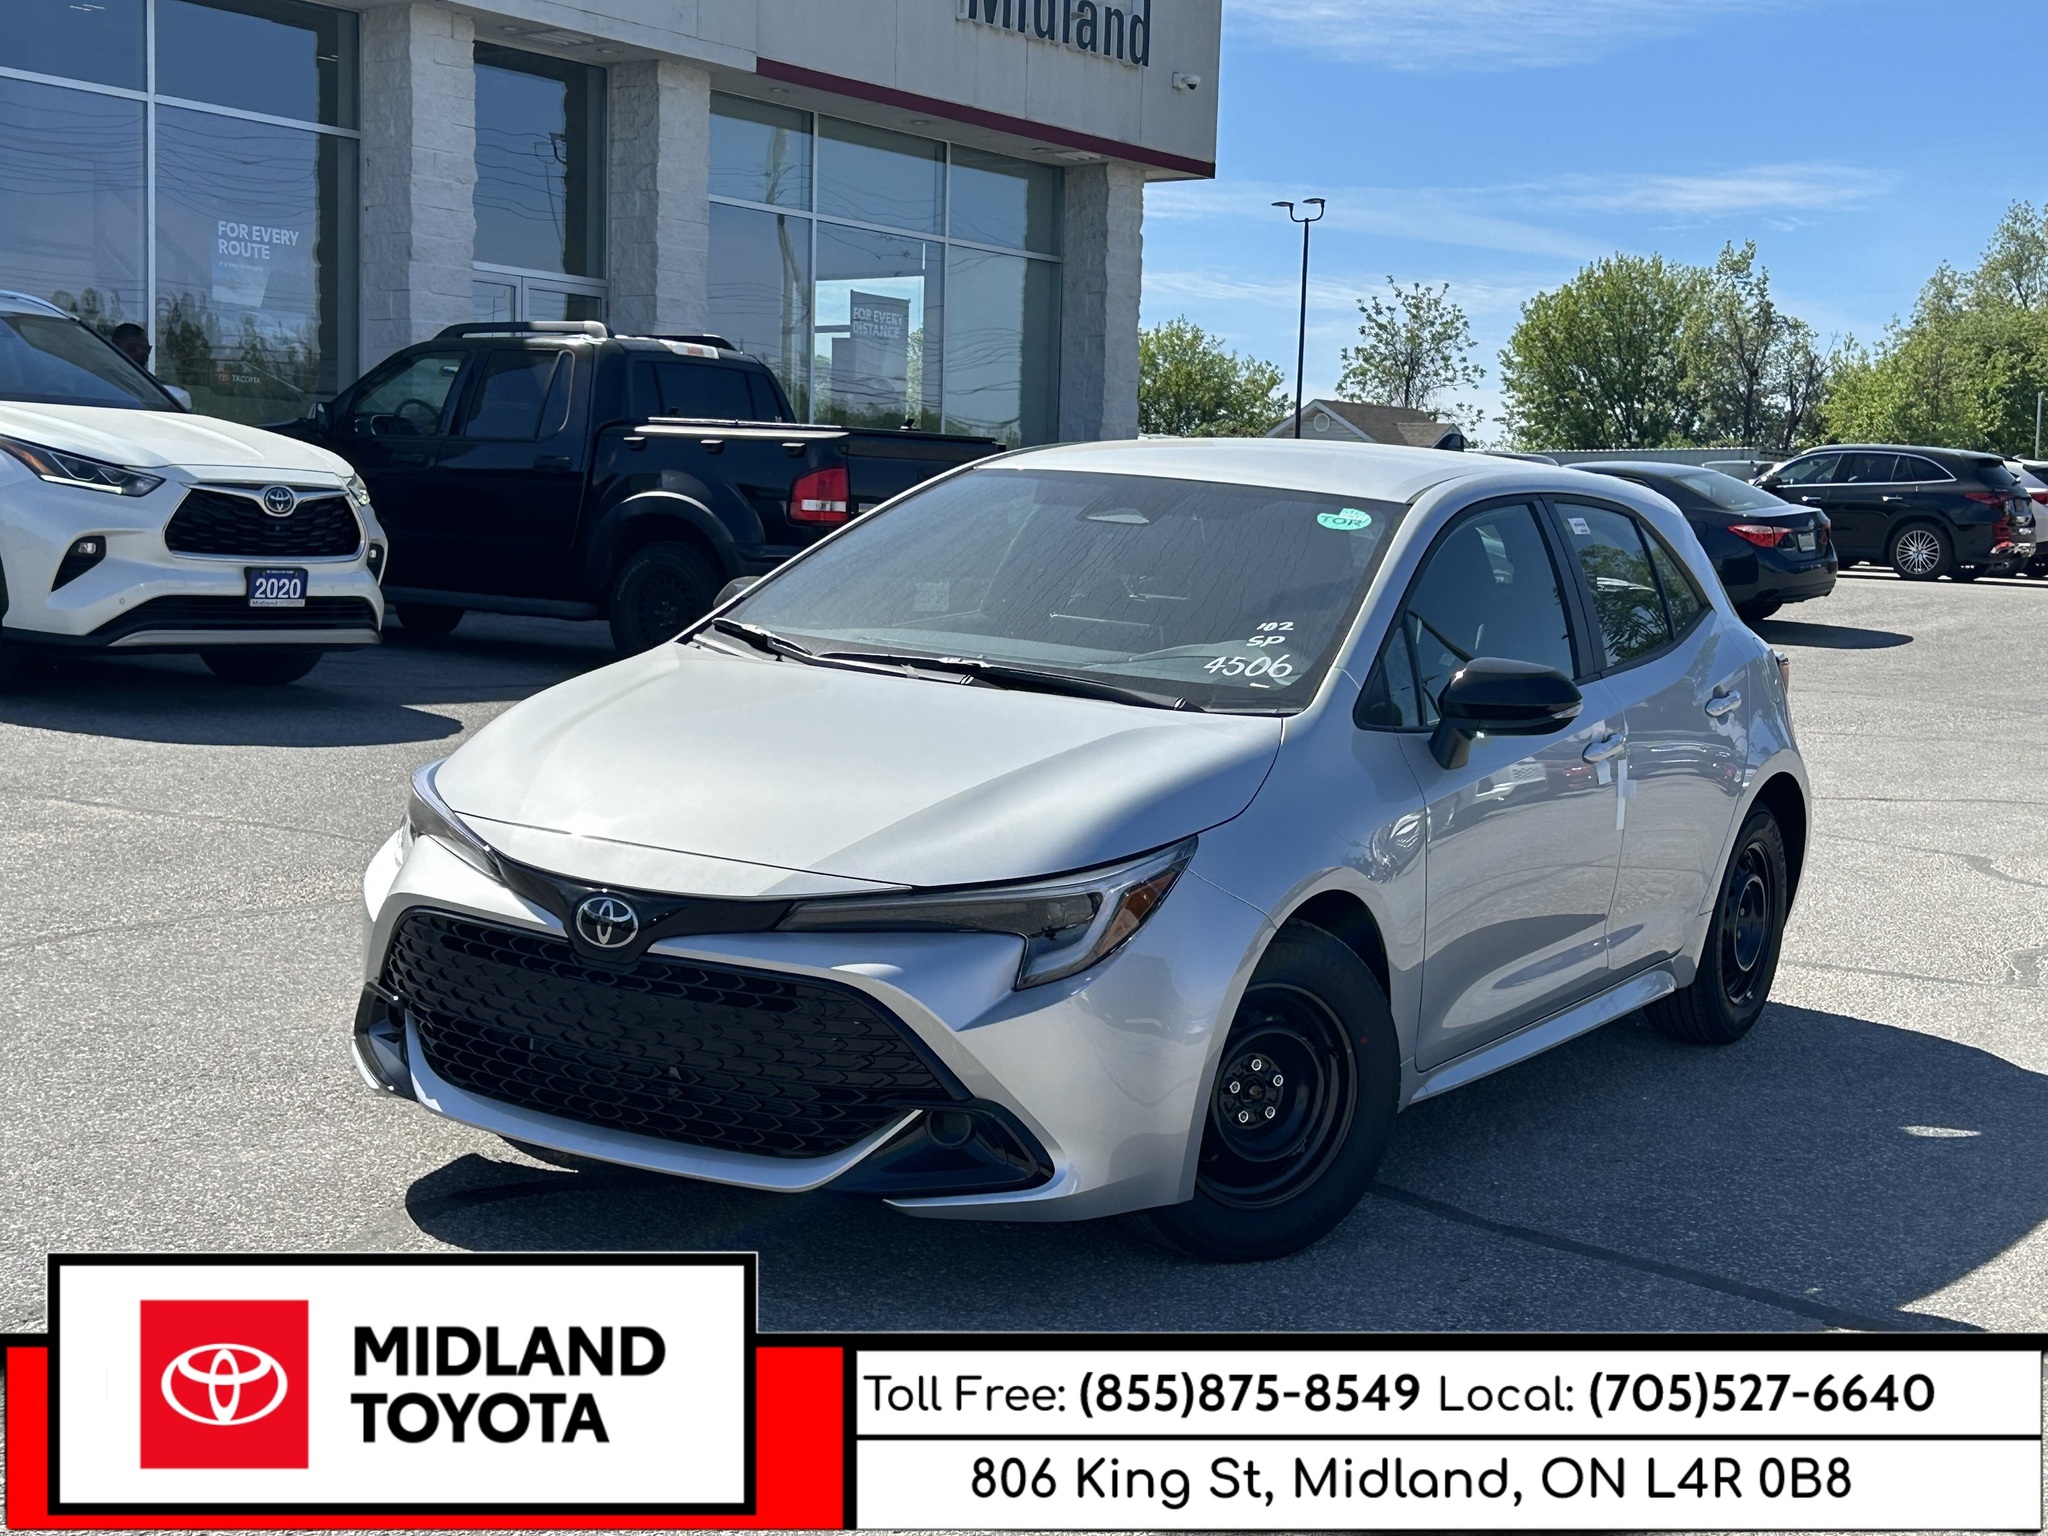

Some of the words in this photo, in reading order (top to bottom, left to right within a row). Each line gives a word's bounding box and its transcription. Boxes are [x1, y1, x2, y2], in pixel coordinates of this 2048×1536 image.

[218, 220, 249, 240] FOR
[252, 225, 299, 247] EVERY
[218, 238, 270, 260] ROUTE
[853, 306, 872, 321] FOR
[254, 577, 301, 599] 2020
[1246, 635, 1286, 648] SP
[1203, 653, 1293, 678] 4506
